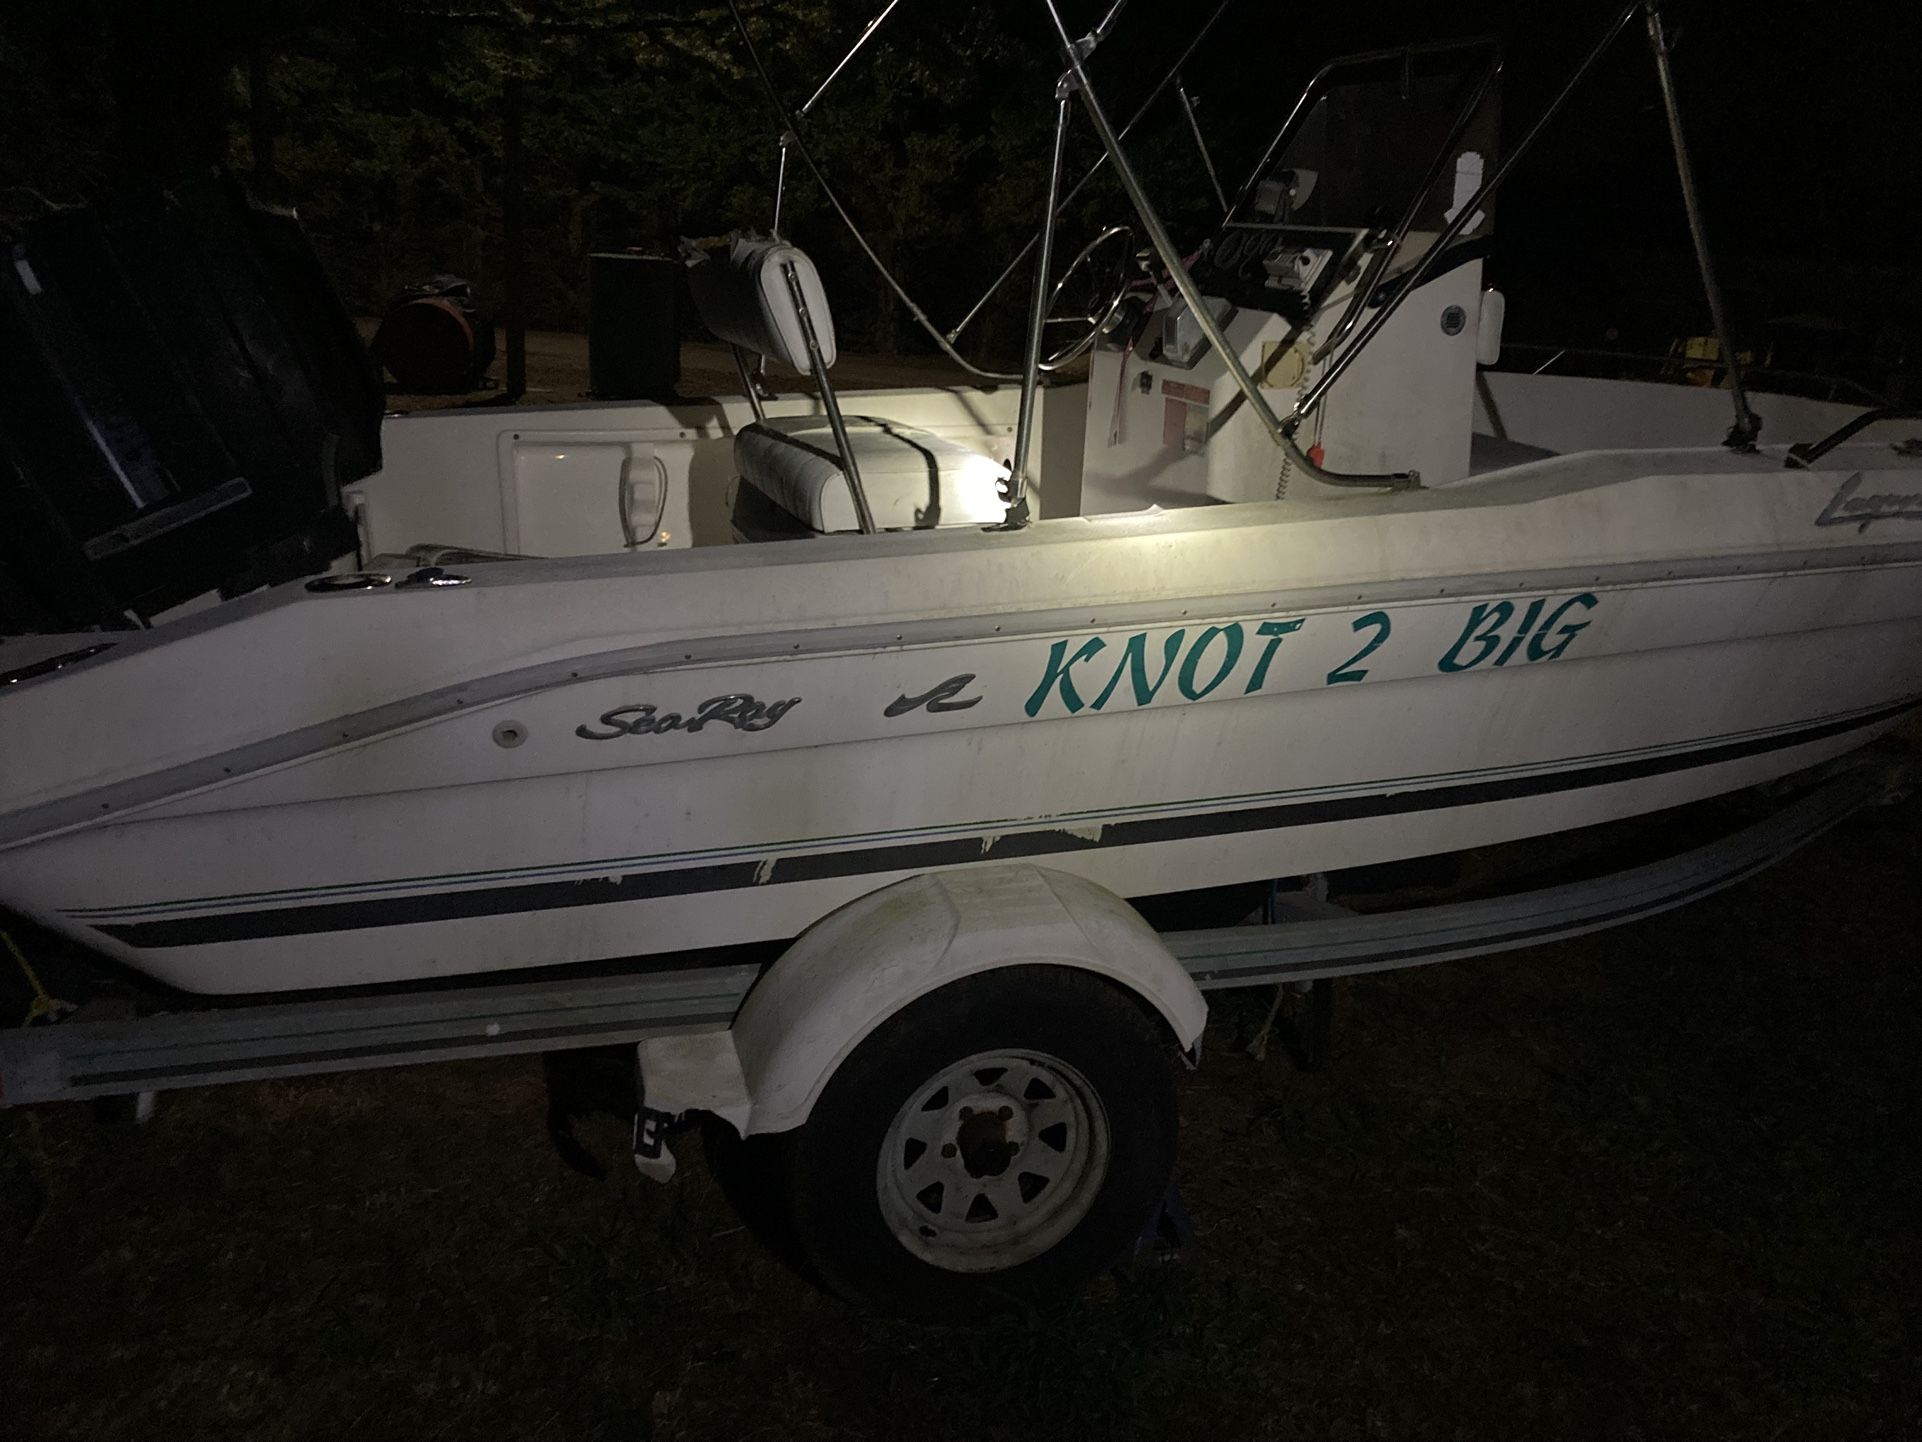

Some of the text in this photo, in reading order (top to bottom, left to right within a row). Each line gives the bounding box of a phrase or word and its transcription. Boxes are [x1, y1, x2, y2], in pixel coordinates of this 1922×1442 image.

[1024, 591, 1599, 718] KNOT 2 BIG
